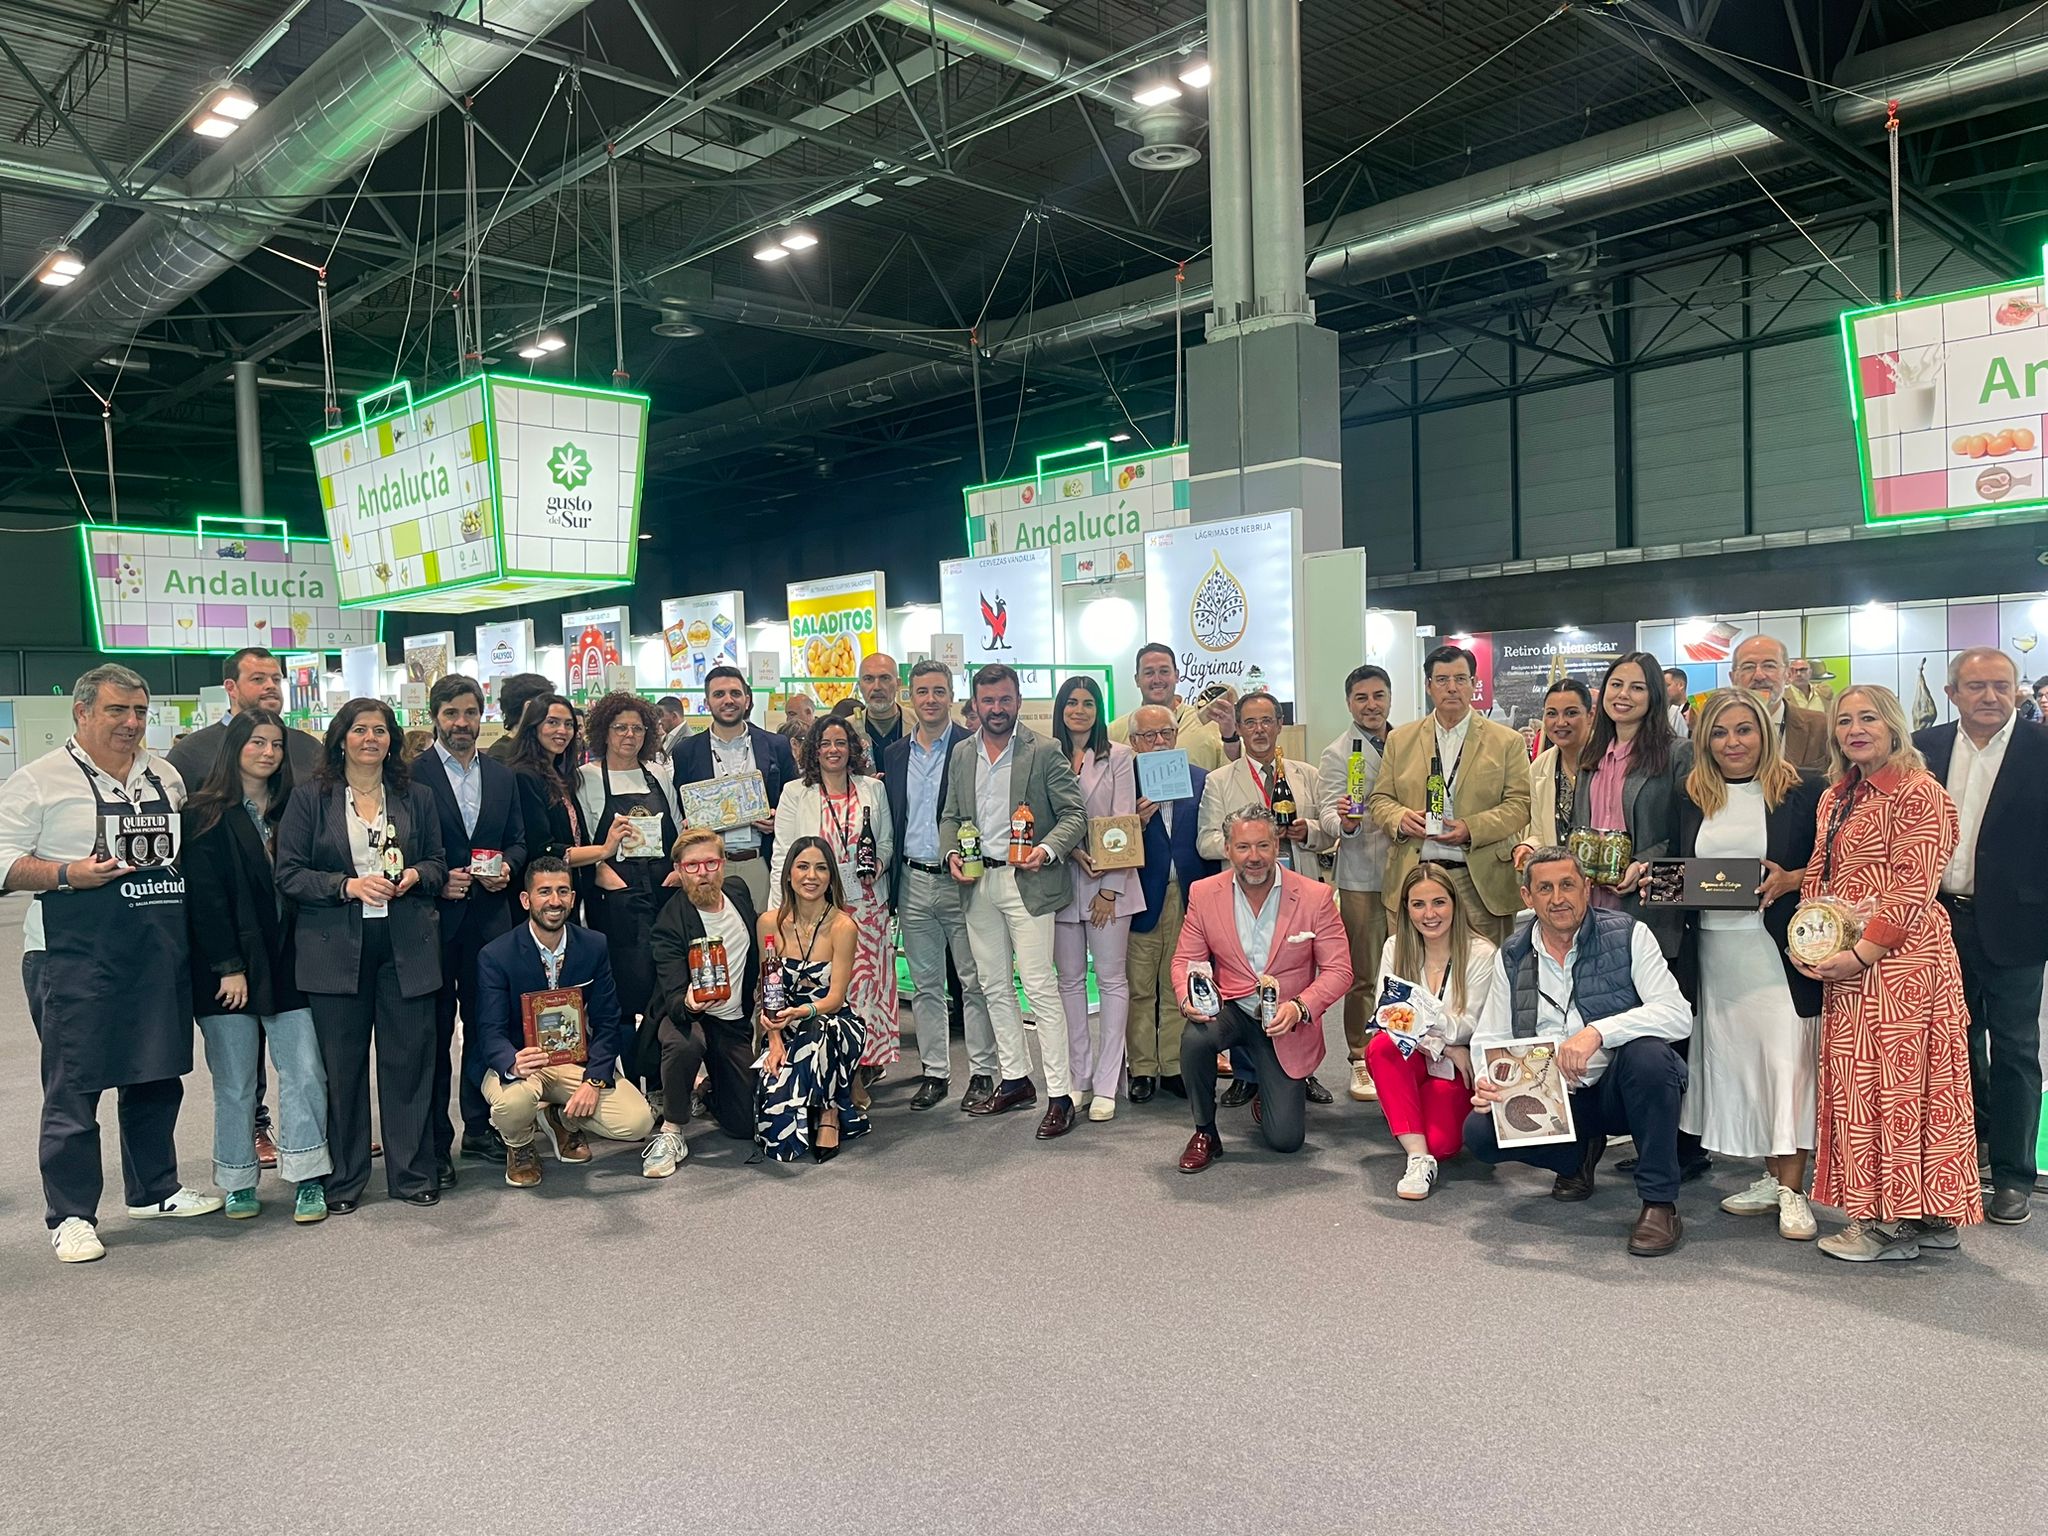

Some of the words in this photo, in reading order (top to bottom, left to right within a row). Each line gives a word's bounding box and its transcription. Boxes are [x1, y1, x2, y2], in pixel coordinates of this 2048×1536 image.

[358, 453, 450, 521] Andalucía
[546, 495, 592, 515] gusto
[549, 516, 561, 525] del
[561, 511, 592, 529] Sur
[1016, 500, 1140, 550] Andalucía
[1231, 526, 1239, 535] DE
[1240, 522, 1272, 534] NEBRIJA
[979, 557, 1008, 568] CERVEZAS
[1008, 553, 1036, 564] VANDALIA
[164, 569, 324, 599] Andalucía
[793, 609, 873, 638] SALADITOS
[492, 650, 513, 660] SALYSOL
[1503, 644, 1540, 658] Retiro
[1542, 643, 1557, 655] de
[1559, 640, 1618, 655] bienestar
[1179, 652, 1245, 689] Lágrimas
[123, 816, 166, 829] QUIETUD
[120, 877, 185, 899] Quietud
